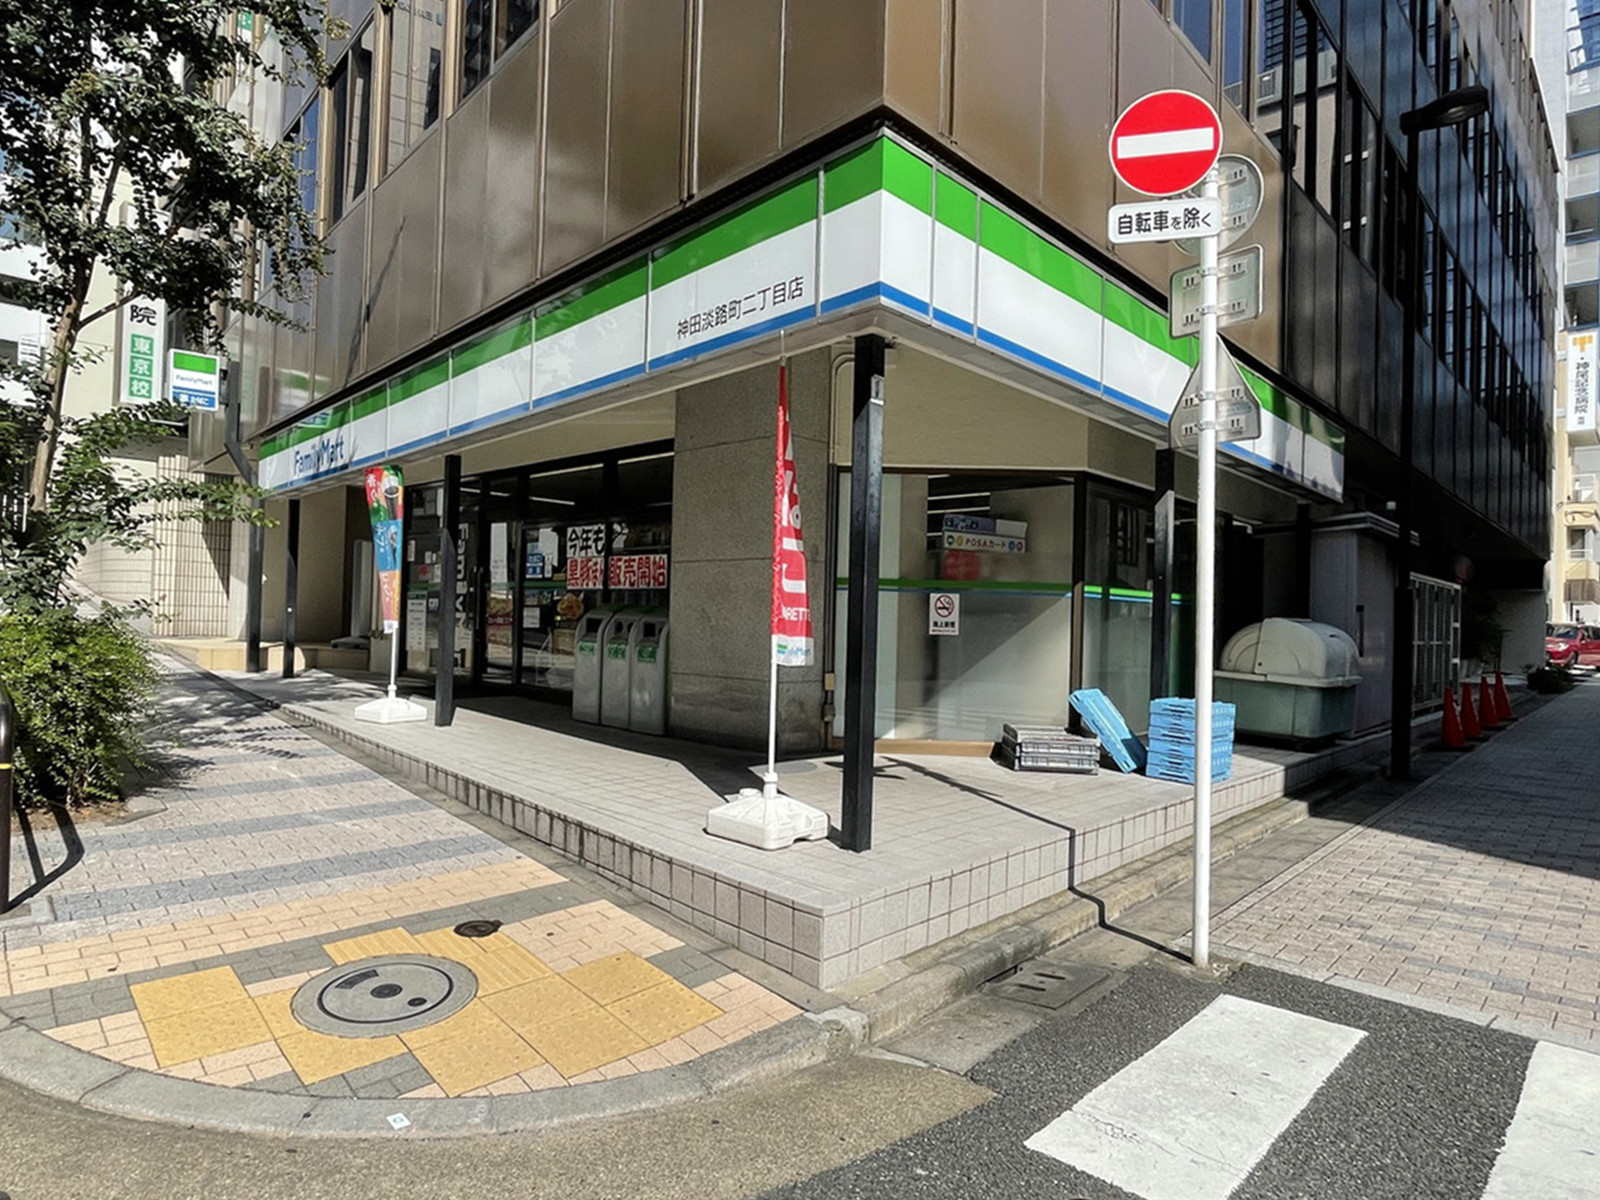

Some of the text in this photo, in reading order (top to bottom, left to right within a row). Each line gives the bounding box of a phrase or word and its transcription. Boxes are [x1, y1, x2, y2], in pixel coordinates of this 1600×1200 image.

[1118, 207, 1211, 235] 自転車を除く
[677, 276, 804, 340] 神田淡路町二丁目店
[130, 336, 152, 397] 東京校
[294, 435, 345, 477] FamilyMart
[568, 526, 605, 556] 今年も
[609, 555, 666, 588] 販売開始
